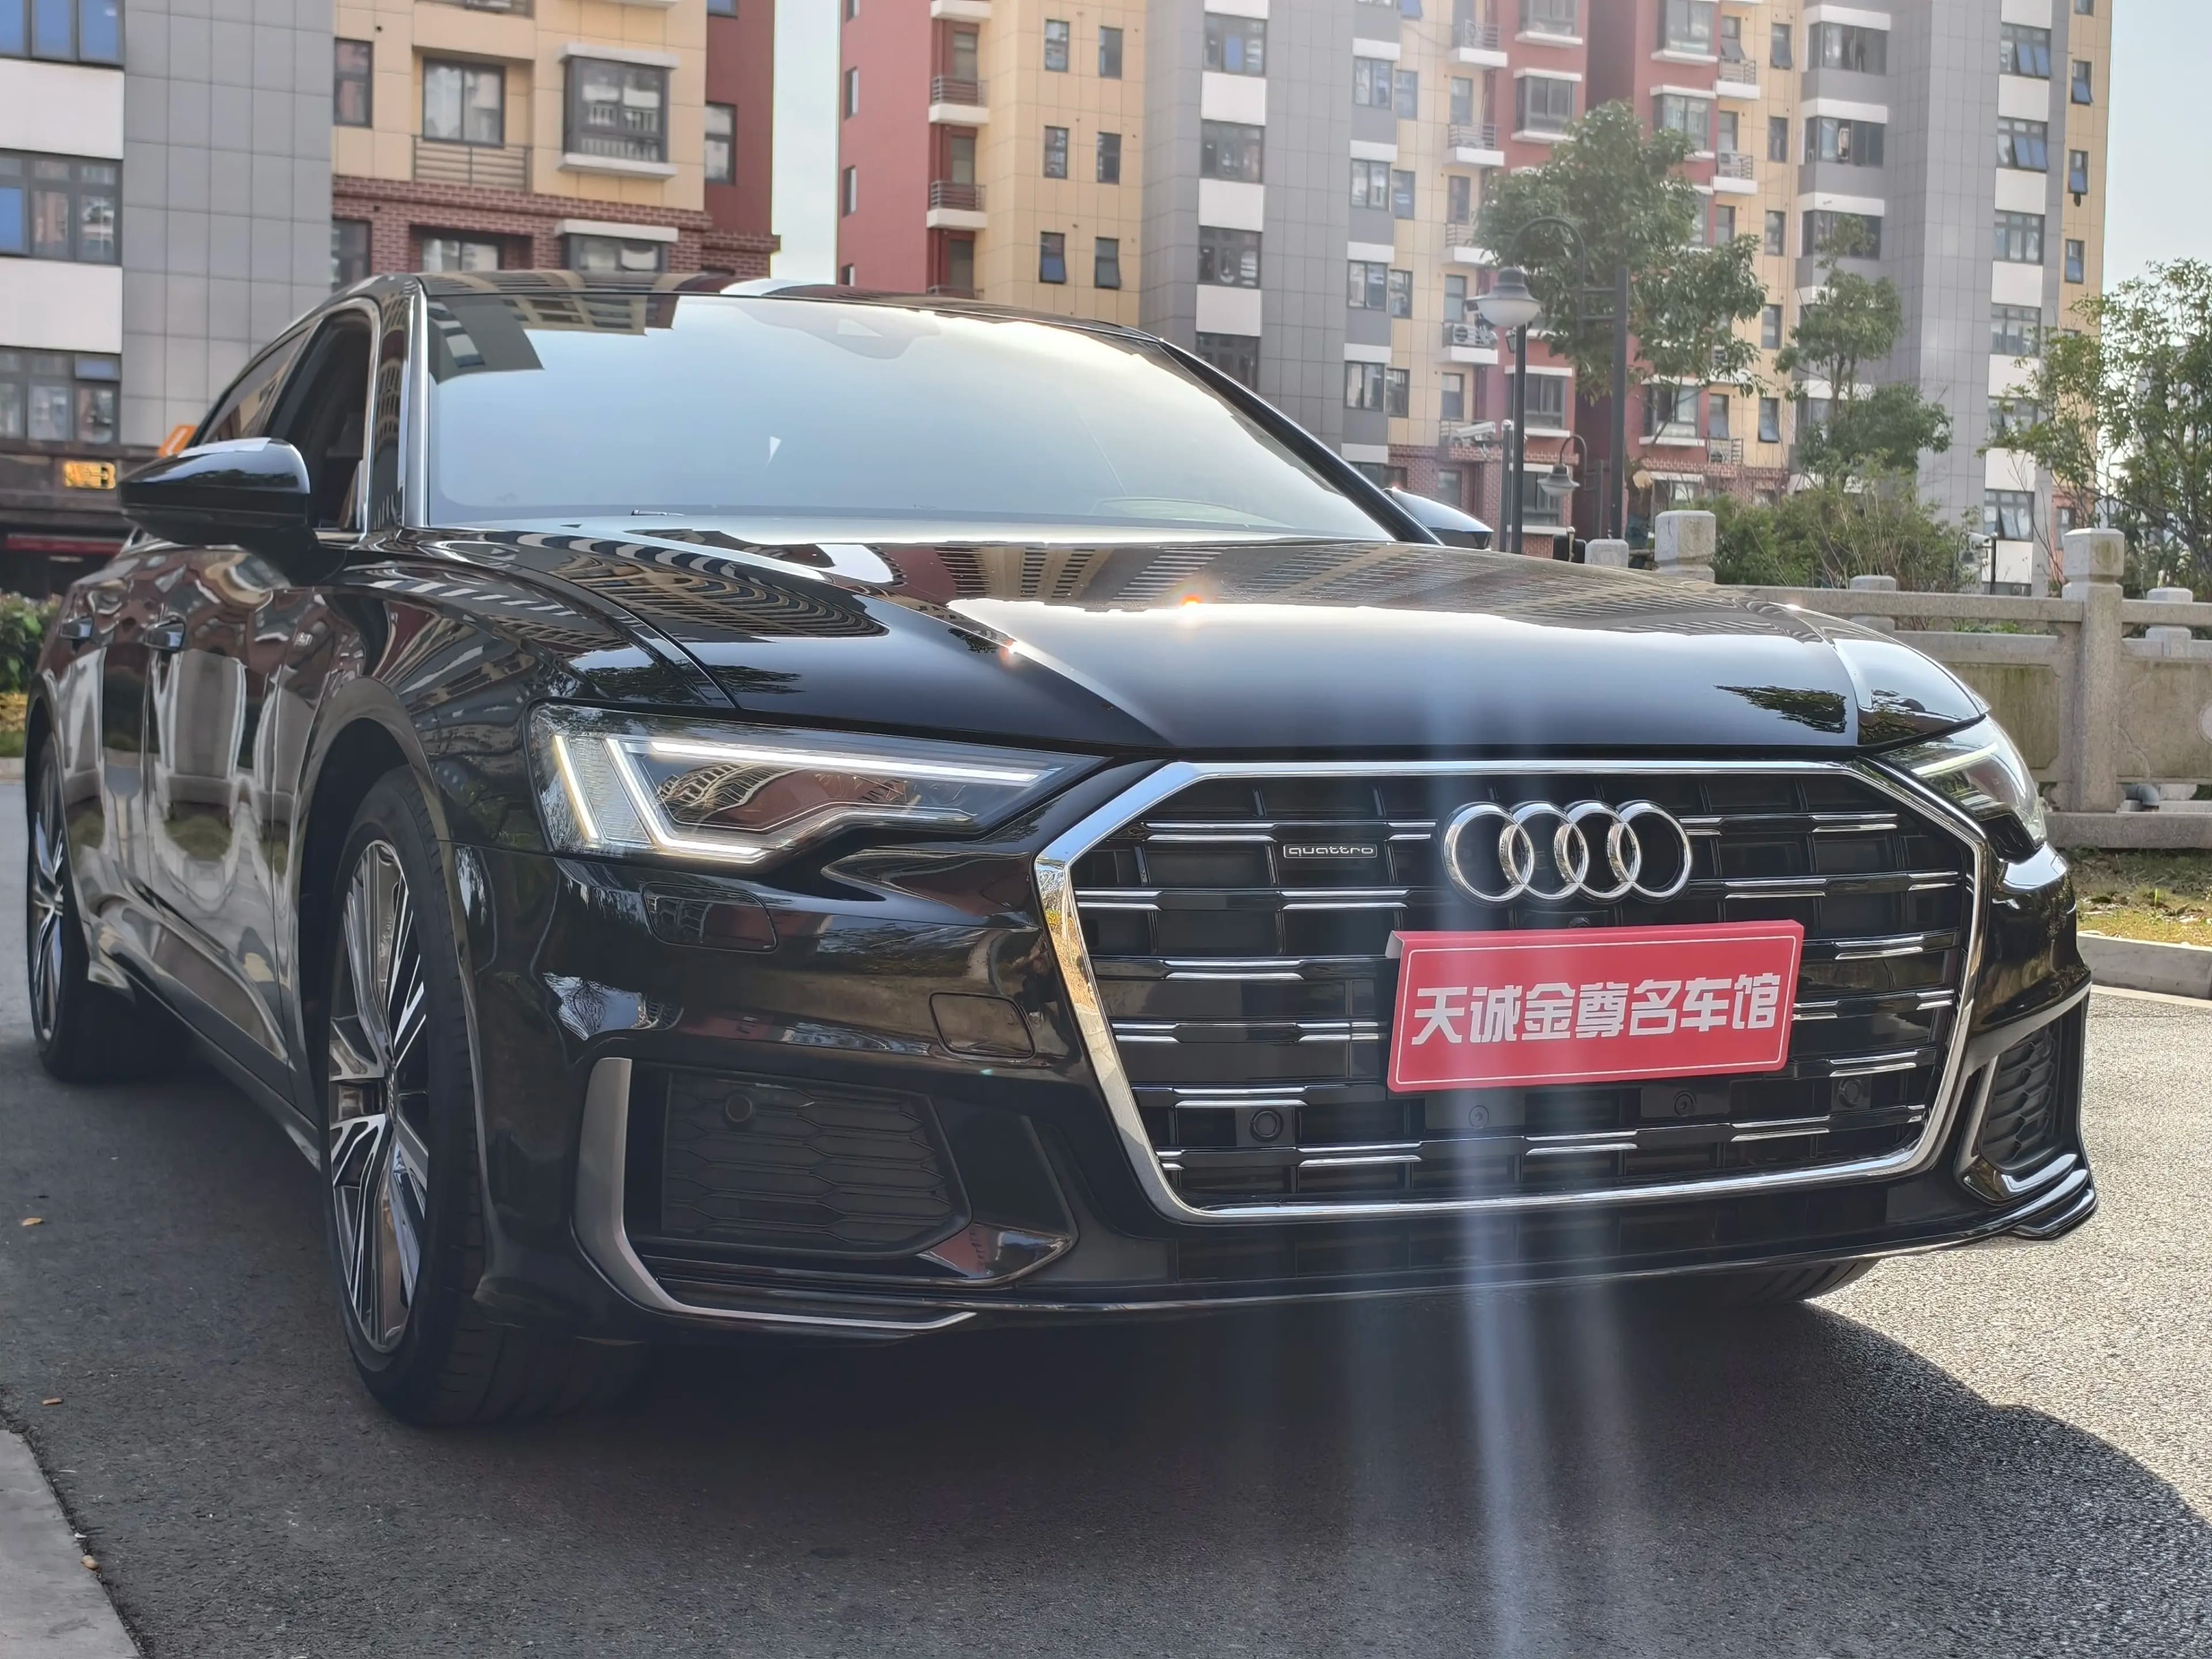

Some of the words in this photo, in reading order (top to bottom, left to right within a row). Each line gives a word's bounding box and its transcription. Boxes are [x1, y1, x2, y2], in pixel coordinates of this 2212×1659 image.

[1288, 846, 1374, 857] quattro
[1411, 973, 1781, 1046] 天诚金尊名车馆
